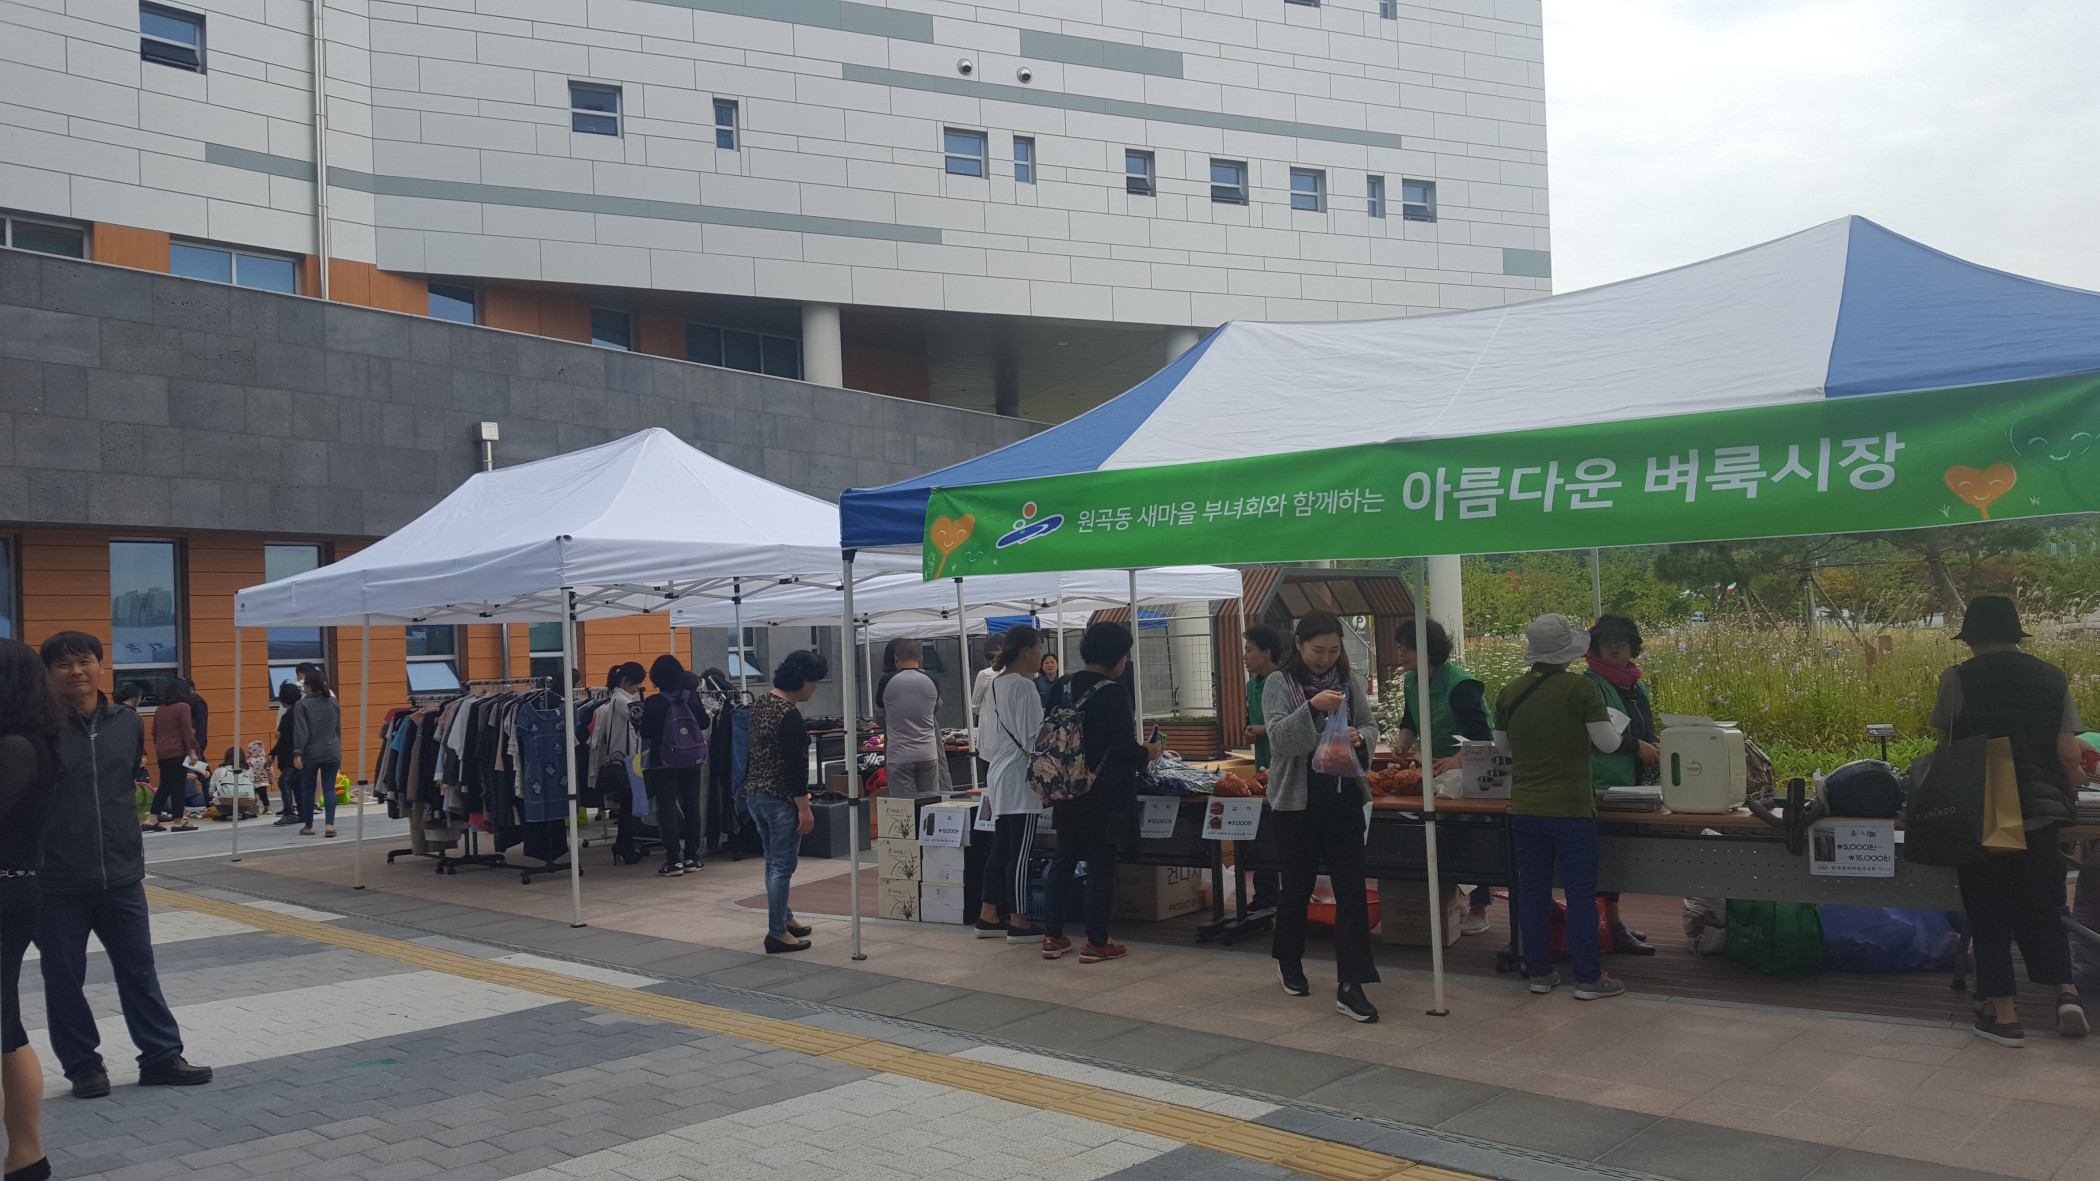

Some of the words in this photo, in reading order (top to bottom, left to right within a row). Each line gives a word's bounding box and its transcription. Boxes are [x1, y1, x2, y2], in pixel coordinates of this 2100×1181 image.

[1402, 458, 1623, 521] 아름다운
[1644, 431, 1906, 503] 벼룩시장
[1078, 507, 1133, 533] 원곡동
[1137, 502, 1198, 528] 새마을
[1202, 494, 1287, 522] 부녀회와
[1293, 488, 1385, 517] 함께하는
